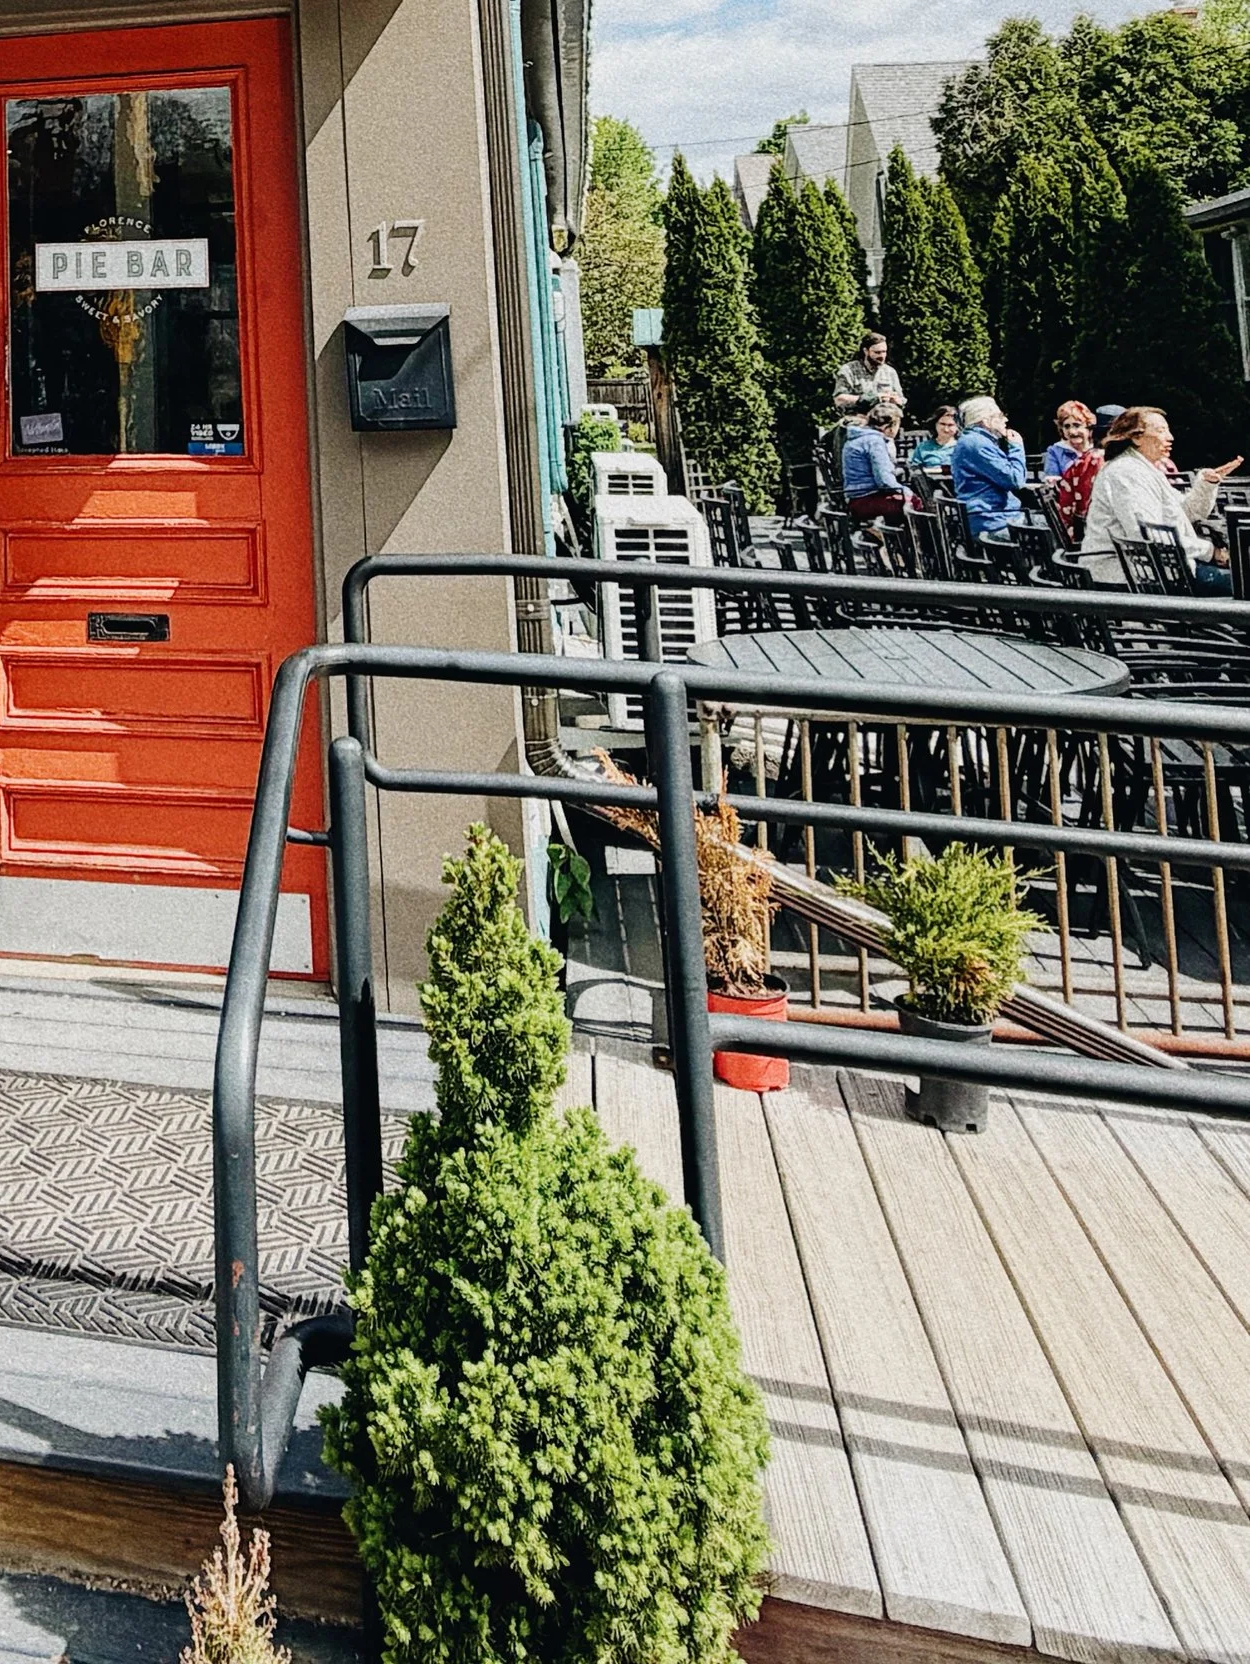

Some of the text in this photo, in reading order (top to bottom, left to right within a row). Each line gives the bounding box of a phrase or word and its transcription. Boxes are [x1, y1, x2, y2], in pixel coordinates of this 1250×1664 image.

[84, 216, 152, 234] FLORENCE
[366, 219, 426, 279] 17
[52, 249, 192, 280] PIE BAR
[75, 294, 108, 321] SWEET
[123, 293, 163, 323] SAVORY
[372, 386, 433, 409] Mail
